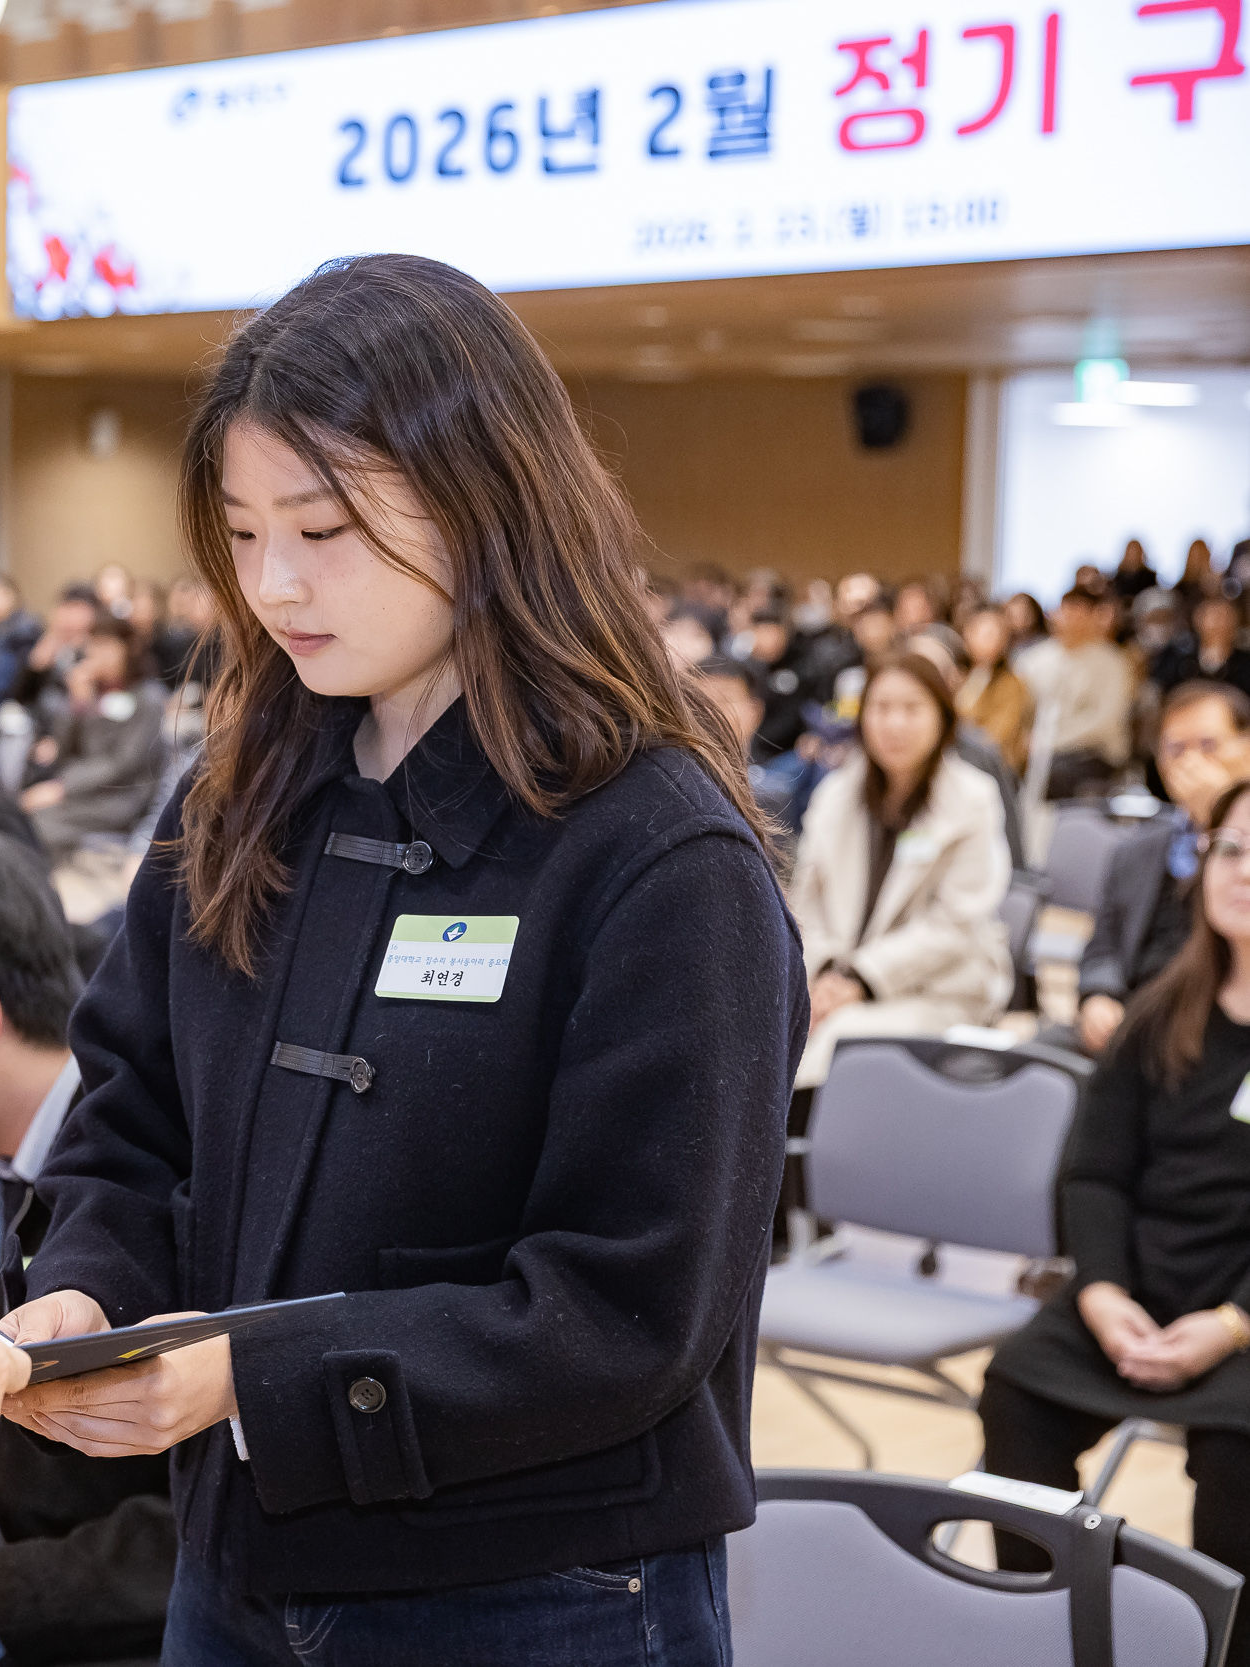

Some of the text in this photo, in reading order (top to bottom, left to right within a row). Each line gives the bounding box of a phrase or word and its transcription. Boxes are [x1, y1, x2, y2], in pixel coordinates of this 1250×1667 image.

[337, 88, 601, 188] 2026년
[647, 66, 774, 160] 2월
[835, 12, 1060, 152] 정기
[1129, 0, 1246, 123] 구
[387, 954, 509, 968] 중앙대학교 집수리 봉사동아리 중요해
[420, 969, 464, 987] 최연경
